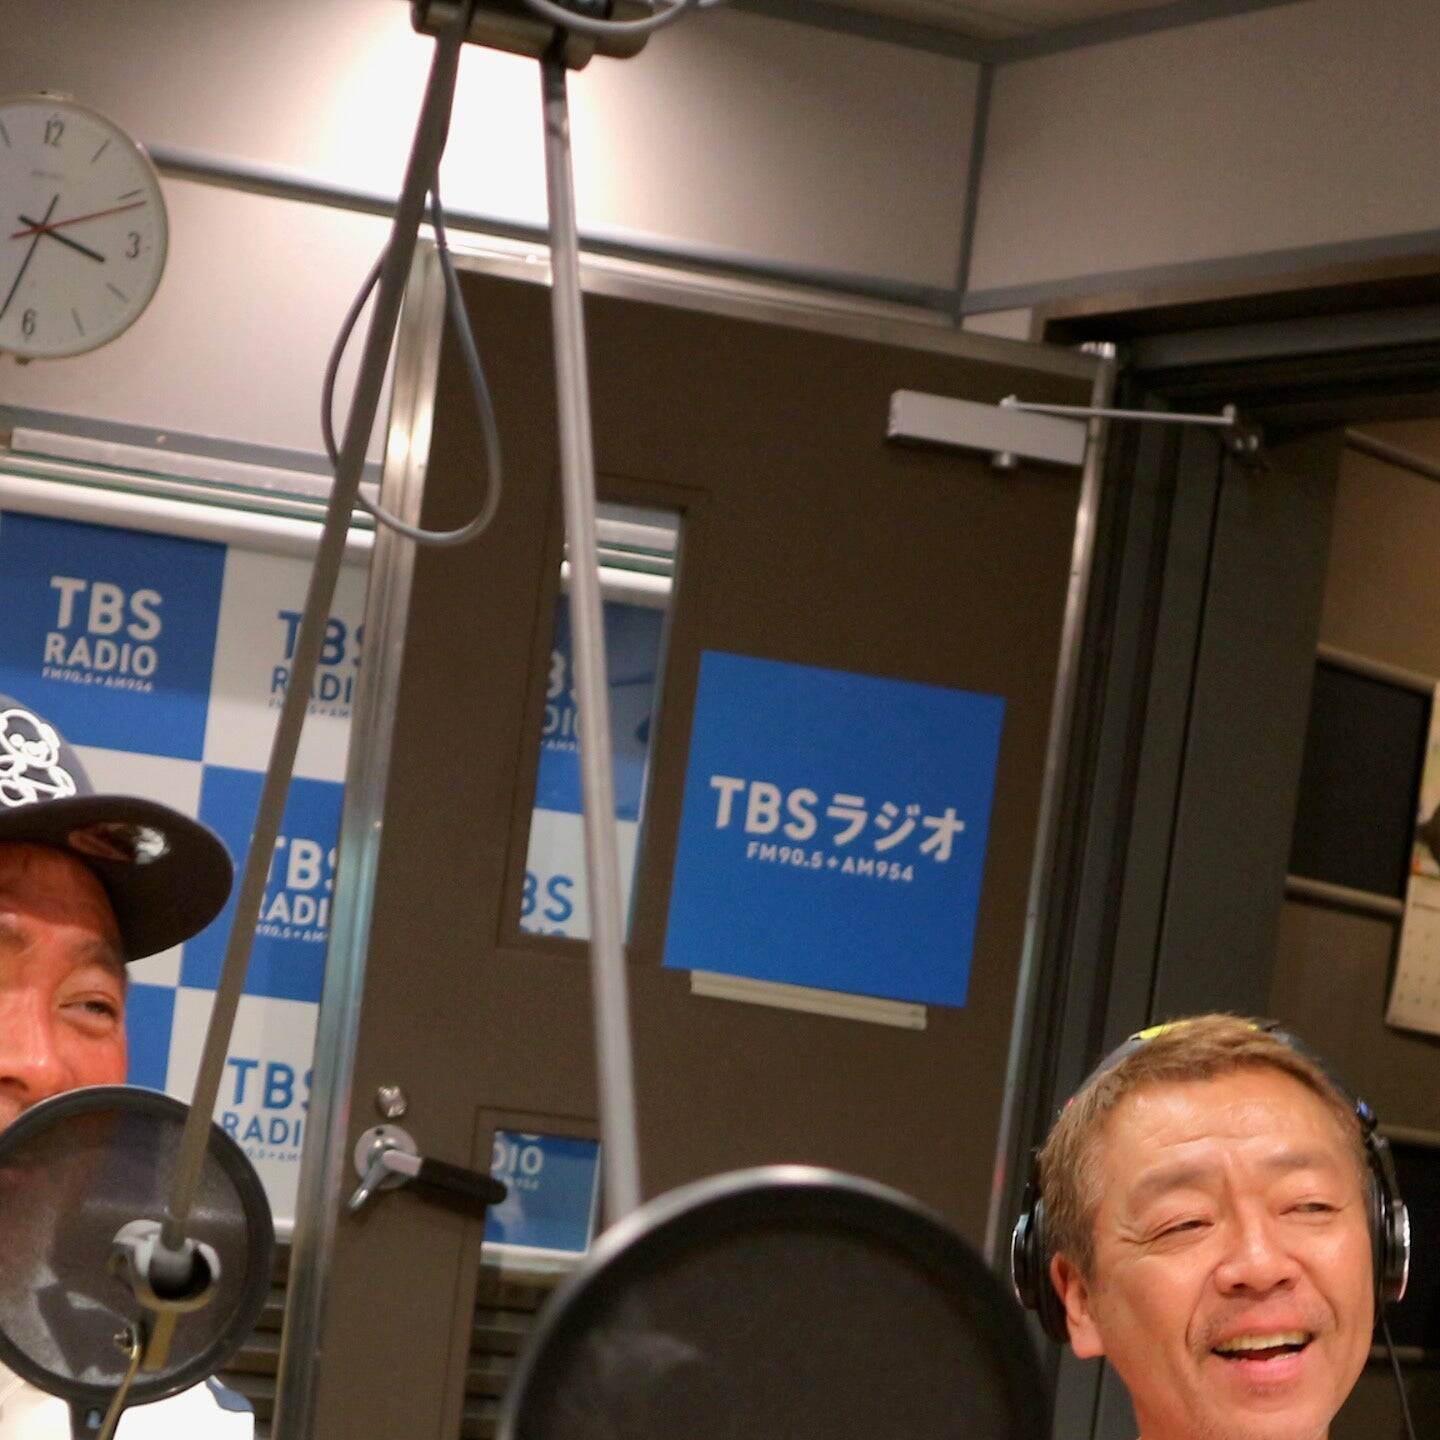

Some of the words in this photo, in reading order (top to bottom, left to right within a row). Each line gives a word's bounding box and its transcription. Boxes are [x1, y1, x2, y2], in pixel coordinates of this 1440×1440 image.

[43, 119, 65, 147] 12
[125, 231, 141, 259] 3
[21, 308, 36, 336] 6
[50, 576, 163, 643] TBS
[44, 633, 159, 678] RADIO
[277, 609, 365, 668] TB
[710, 775, 966, 863] TBSラジオ
[226, 1057, 313, 1112] TB
